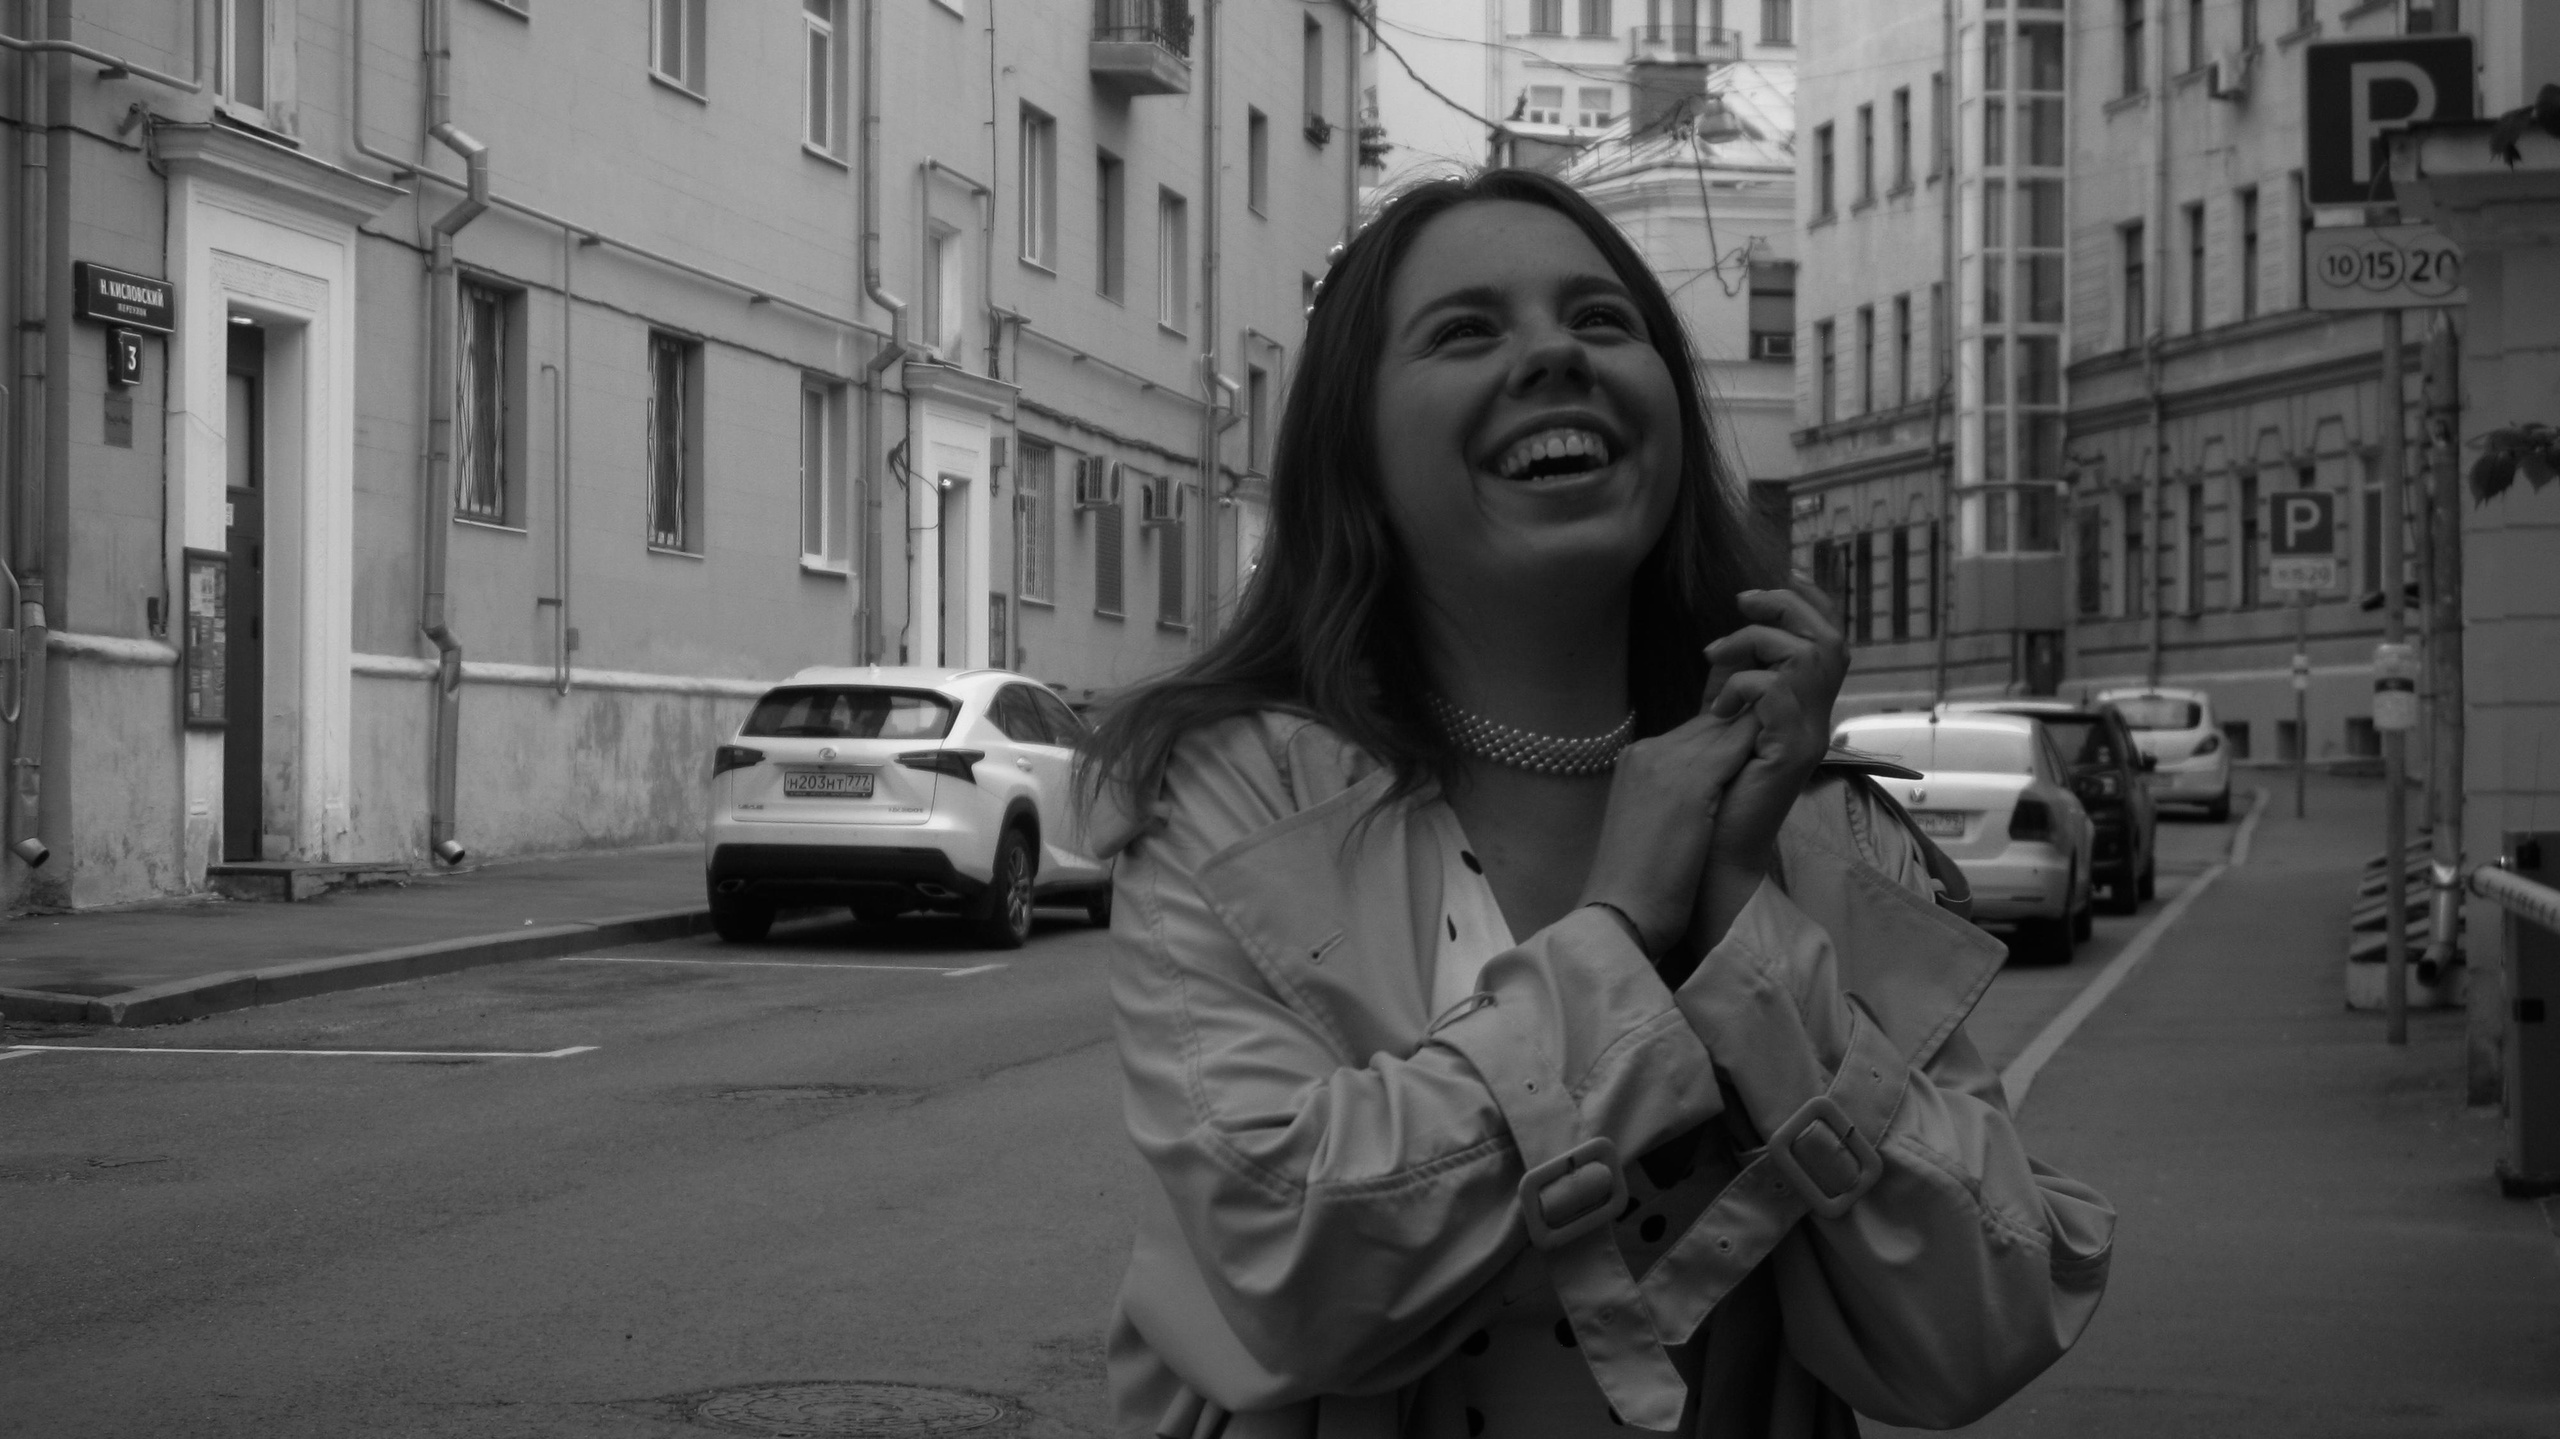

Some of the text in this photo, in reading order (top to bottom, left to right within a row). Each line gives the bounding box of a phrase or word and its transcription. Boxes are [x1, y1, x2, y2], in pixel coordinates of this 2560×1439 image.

[2350, 60, 2437, 183] P
[2327, 254, 2353, 277] 10
[2364, 251, 2396, 280] 15
[109, 280, 164, 308] КИСЛОВСКИЙ
[128, 345, 137, 371] 3
[2286, 499, 2321, 548] P
[847, 775, 869, 786] 777
